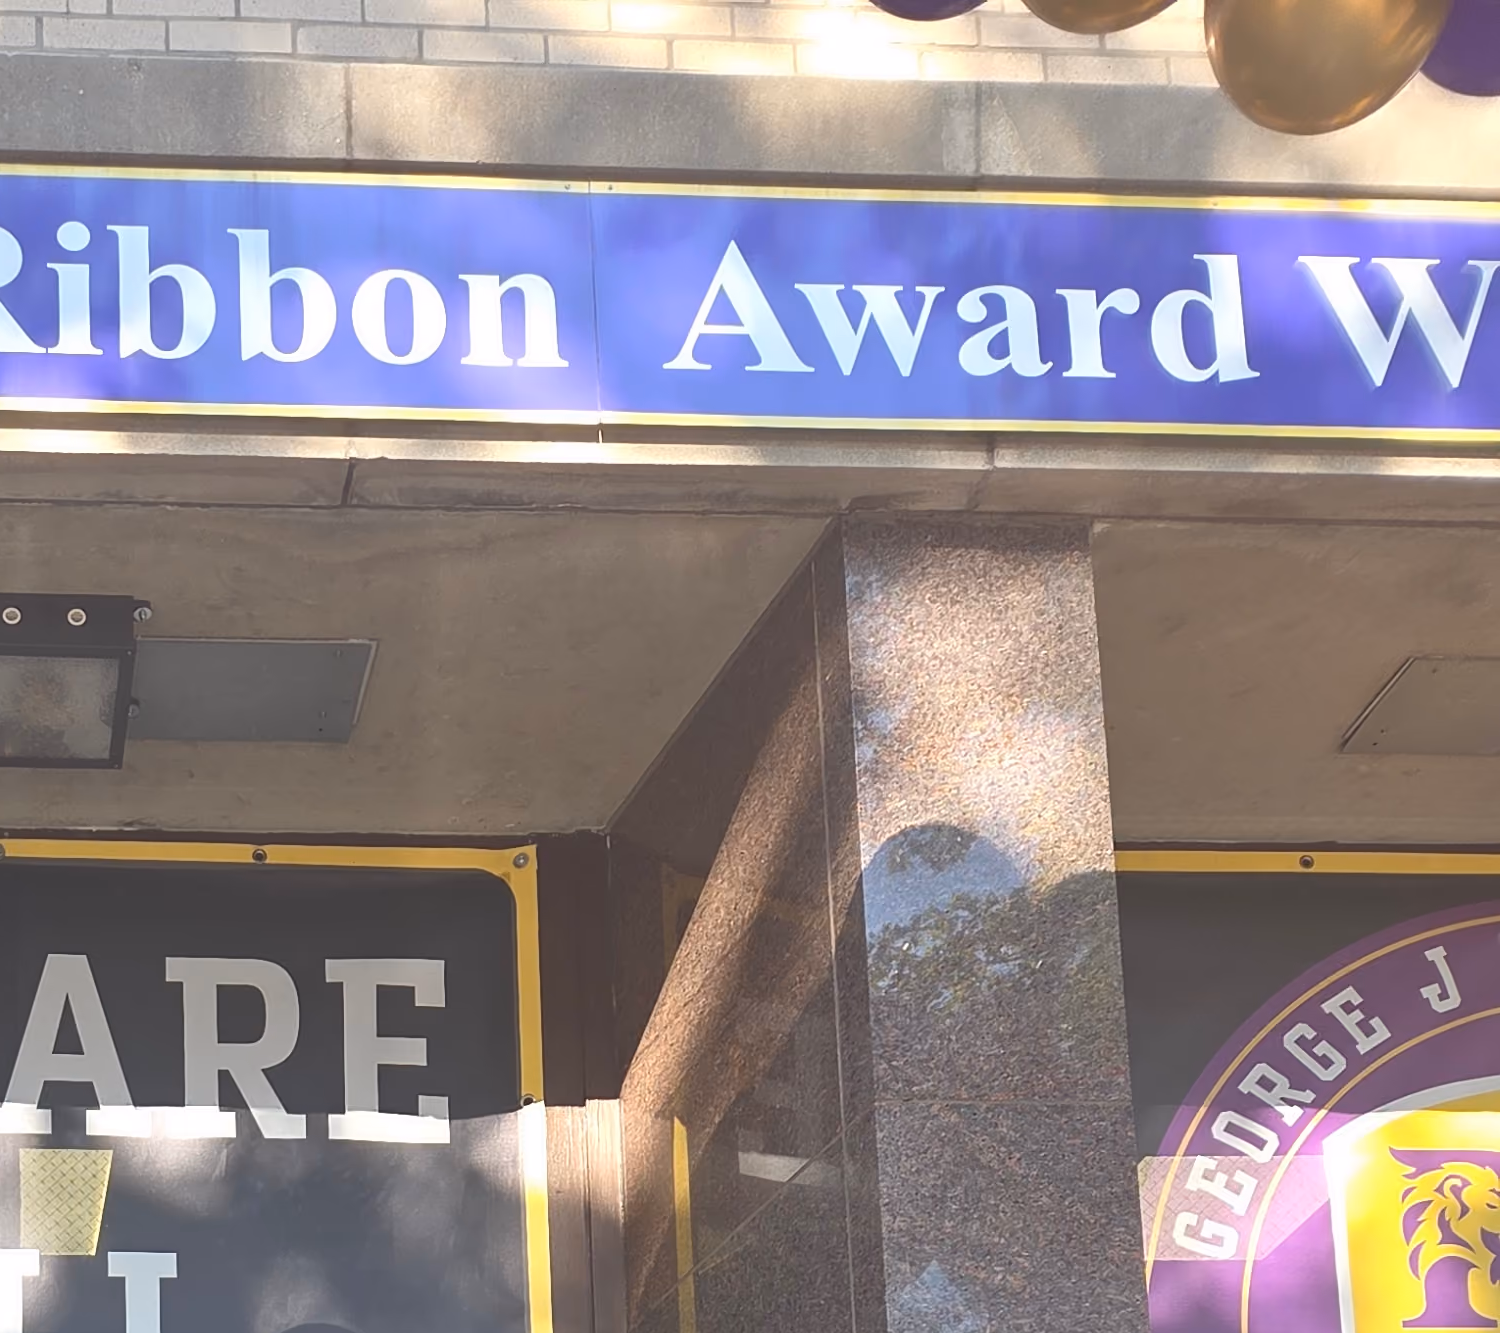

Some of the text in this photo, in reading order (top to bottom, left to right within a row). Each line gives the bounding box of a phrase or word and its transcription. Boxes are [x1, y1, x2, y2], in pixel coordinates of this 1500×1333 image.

[664, 239, 1261, 384] Award
[1173, 985, 1391, 1260] GEORGE
[1420, 946, 1461, 1013] J
